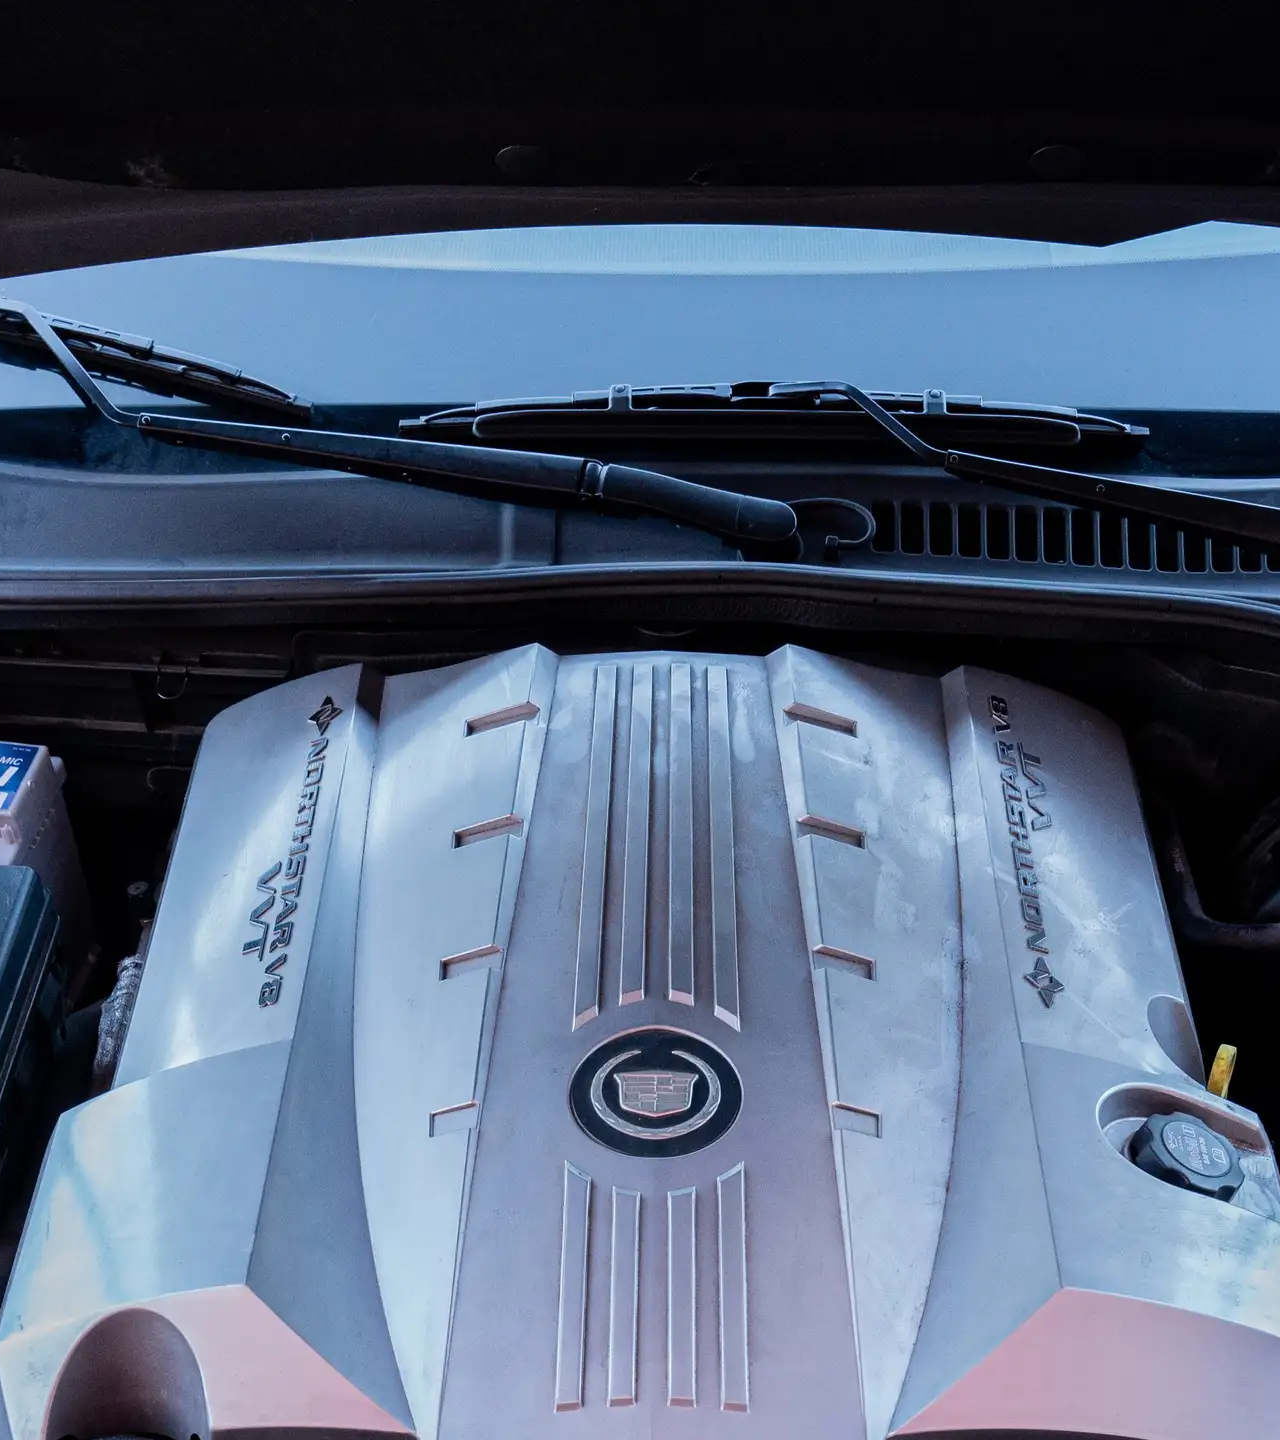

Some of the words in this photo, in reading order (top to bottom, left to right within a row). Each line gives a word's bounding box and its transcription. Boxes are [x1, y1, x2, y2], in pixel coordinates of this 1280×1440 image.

[988, 693, 1012, 734] V8
[1018, 741, 1053, 831] VVT
[268, 737, 329, 954] NORTHSTAR
[993, 740, 1050, 956] NORTHSTAR
[242, 861, 283, 963] VVT
[258, 953, 288, 1009] V8
